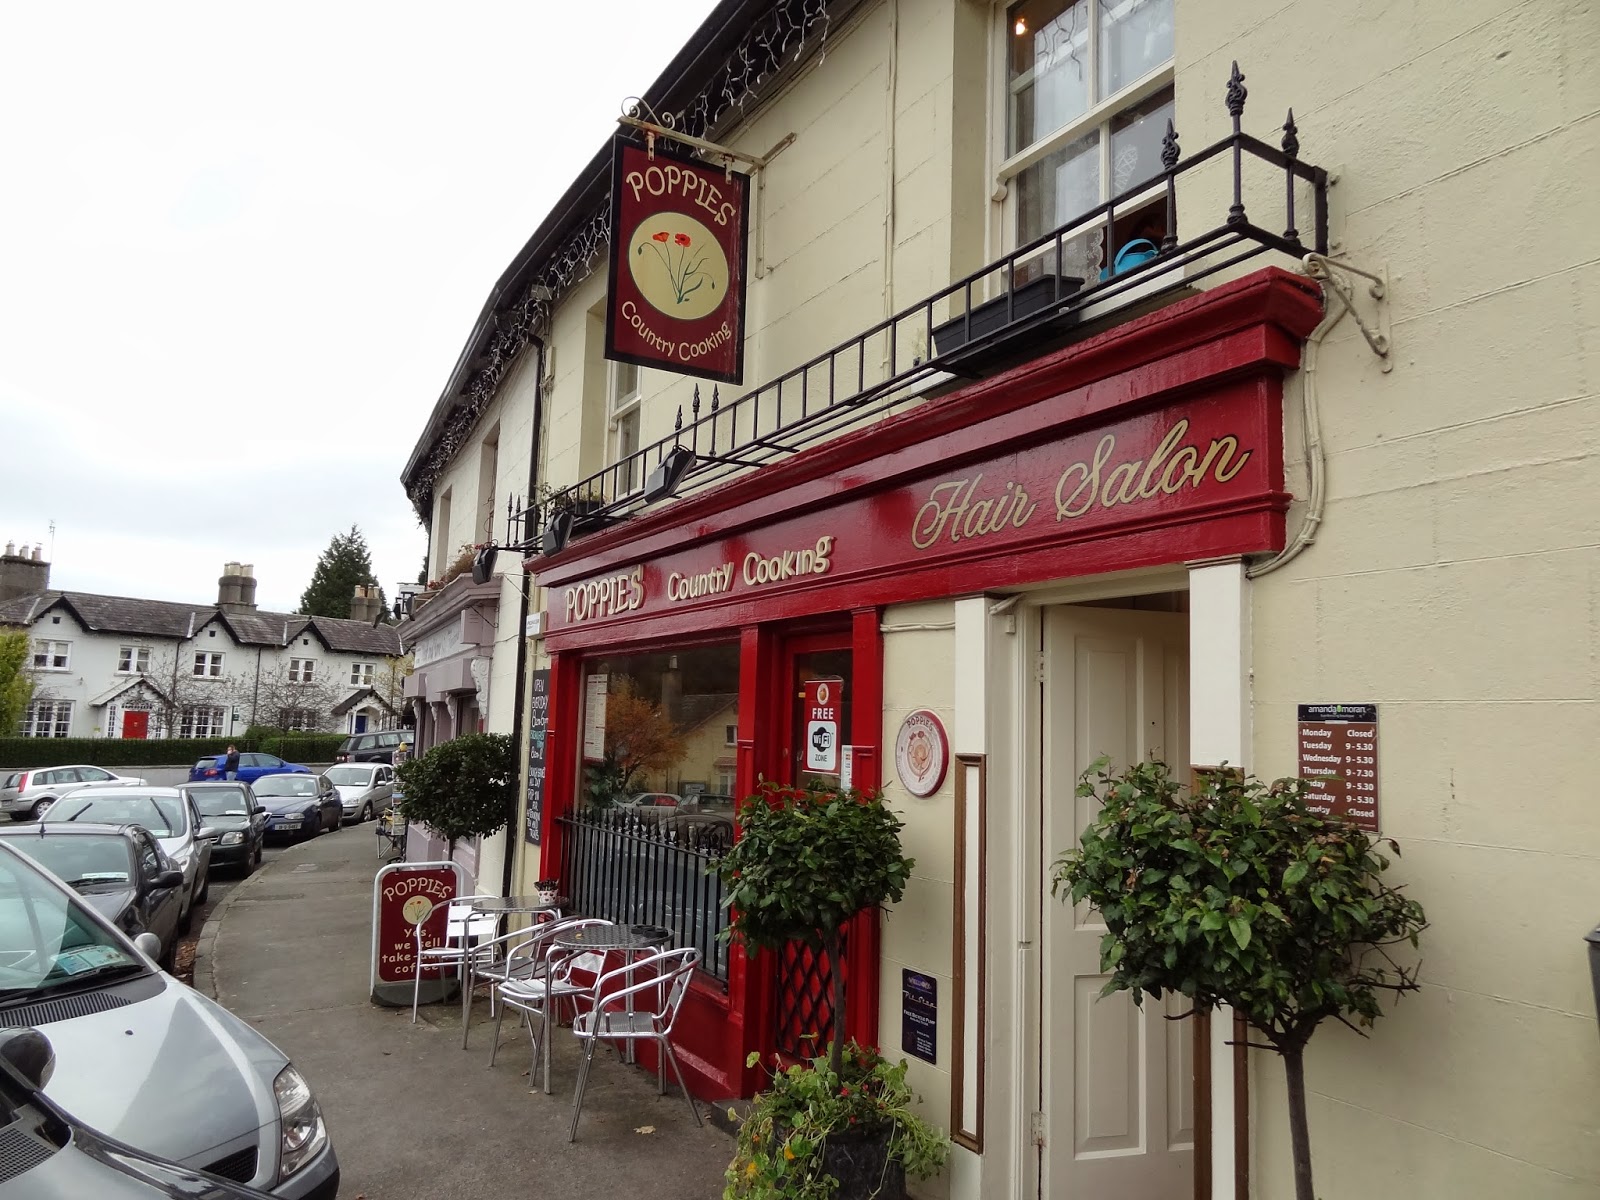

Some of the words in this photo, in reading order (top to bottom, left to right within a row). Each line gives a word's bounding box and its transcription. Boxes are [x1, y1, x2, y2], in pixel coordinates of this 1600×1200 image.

[626, 165, 736, 226] POPPIES
[621, 300, 675, 357] Country
[678, 321, 732, 362] Cooking
[911, 473, 1039, 550] Hair
[1054, 418, 1254, 522] Salon
[565, 564, 644, 623] POPPIES
[667, 562, 735, 602] Country
[742, 536, 835, 587] Cooking
[812, 708, 834, 719] FREE
[907, 716, 933, 731] POPPIES
[1302, 729, 1332, 738] Monday
[1347, 730, 1373, 738] Closed
[1302, 742, 1332, 750] Tuesday
[1302, 754, 1341, 764] Wednesday
[1303, 766, 1336, 774] Thursday
[1303, 792, 1336, 802] Saturday
[1305, 806, 1330, 815] unday
[1348, 808, 1374, 817] Closed
[383, 877, 452, 901] POPPIES
